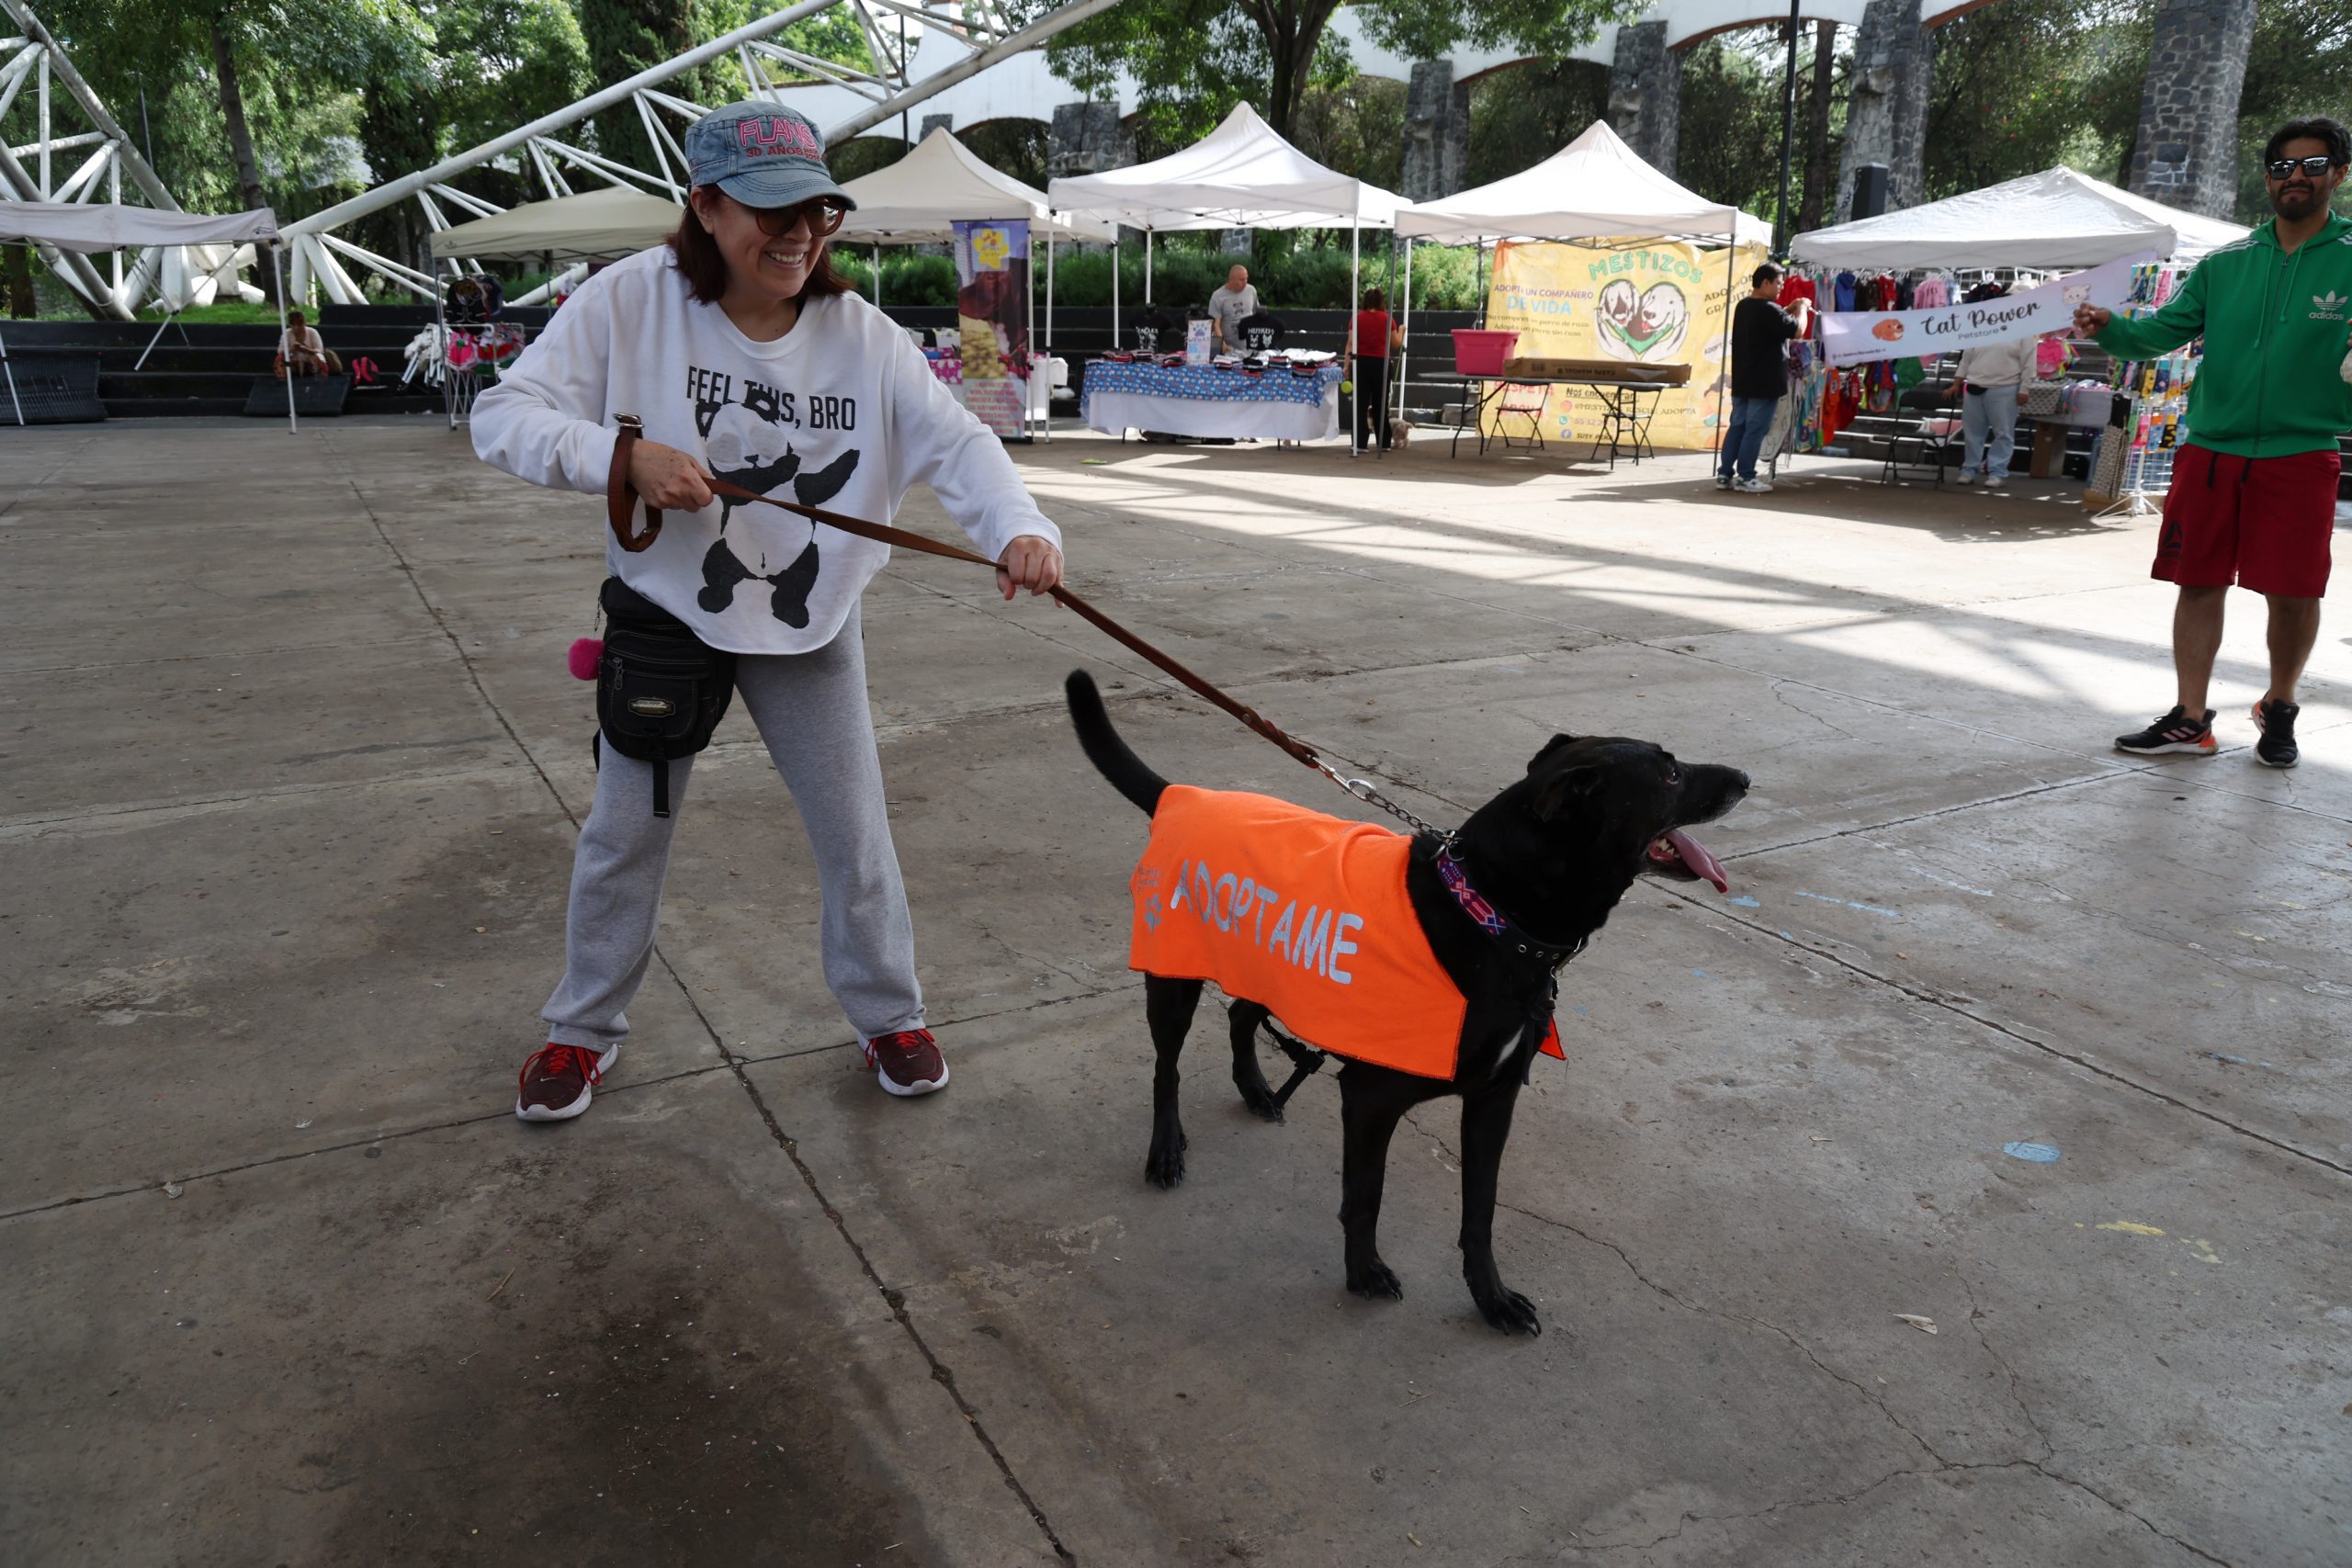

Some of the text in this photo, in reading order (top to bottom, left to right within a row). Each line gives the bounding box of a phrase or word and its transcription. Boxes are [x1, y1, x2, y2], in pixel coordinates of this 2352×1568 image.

[738, 118, 817, 148] FLANS
[746, 143, 804, 157] 30 AÑOS
[1589, 250, 1703, 284] MESTIZOS
[1525, 288, 1537, 297] UN
[1531, 299, 1572, 316] VIDA
[1920, 302, 2041, 335] Cat Power
[2308, 311, 2345, 321] adidas
[1958, 328, 1999, 340] Petstore
[686, 366, 732, 405] FEEL
[808, 395, 856, 431] BRO
[1170, 858, 1364, 985] ADOPTAME
